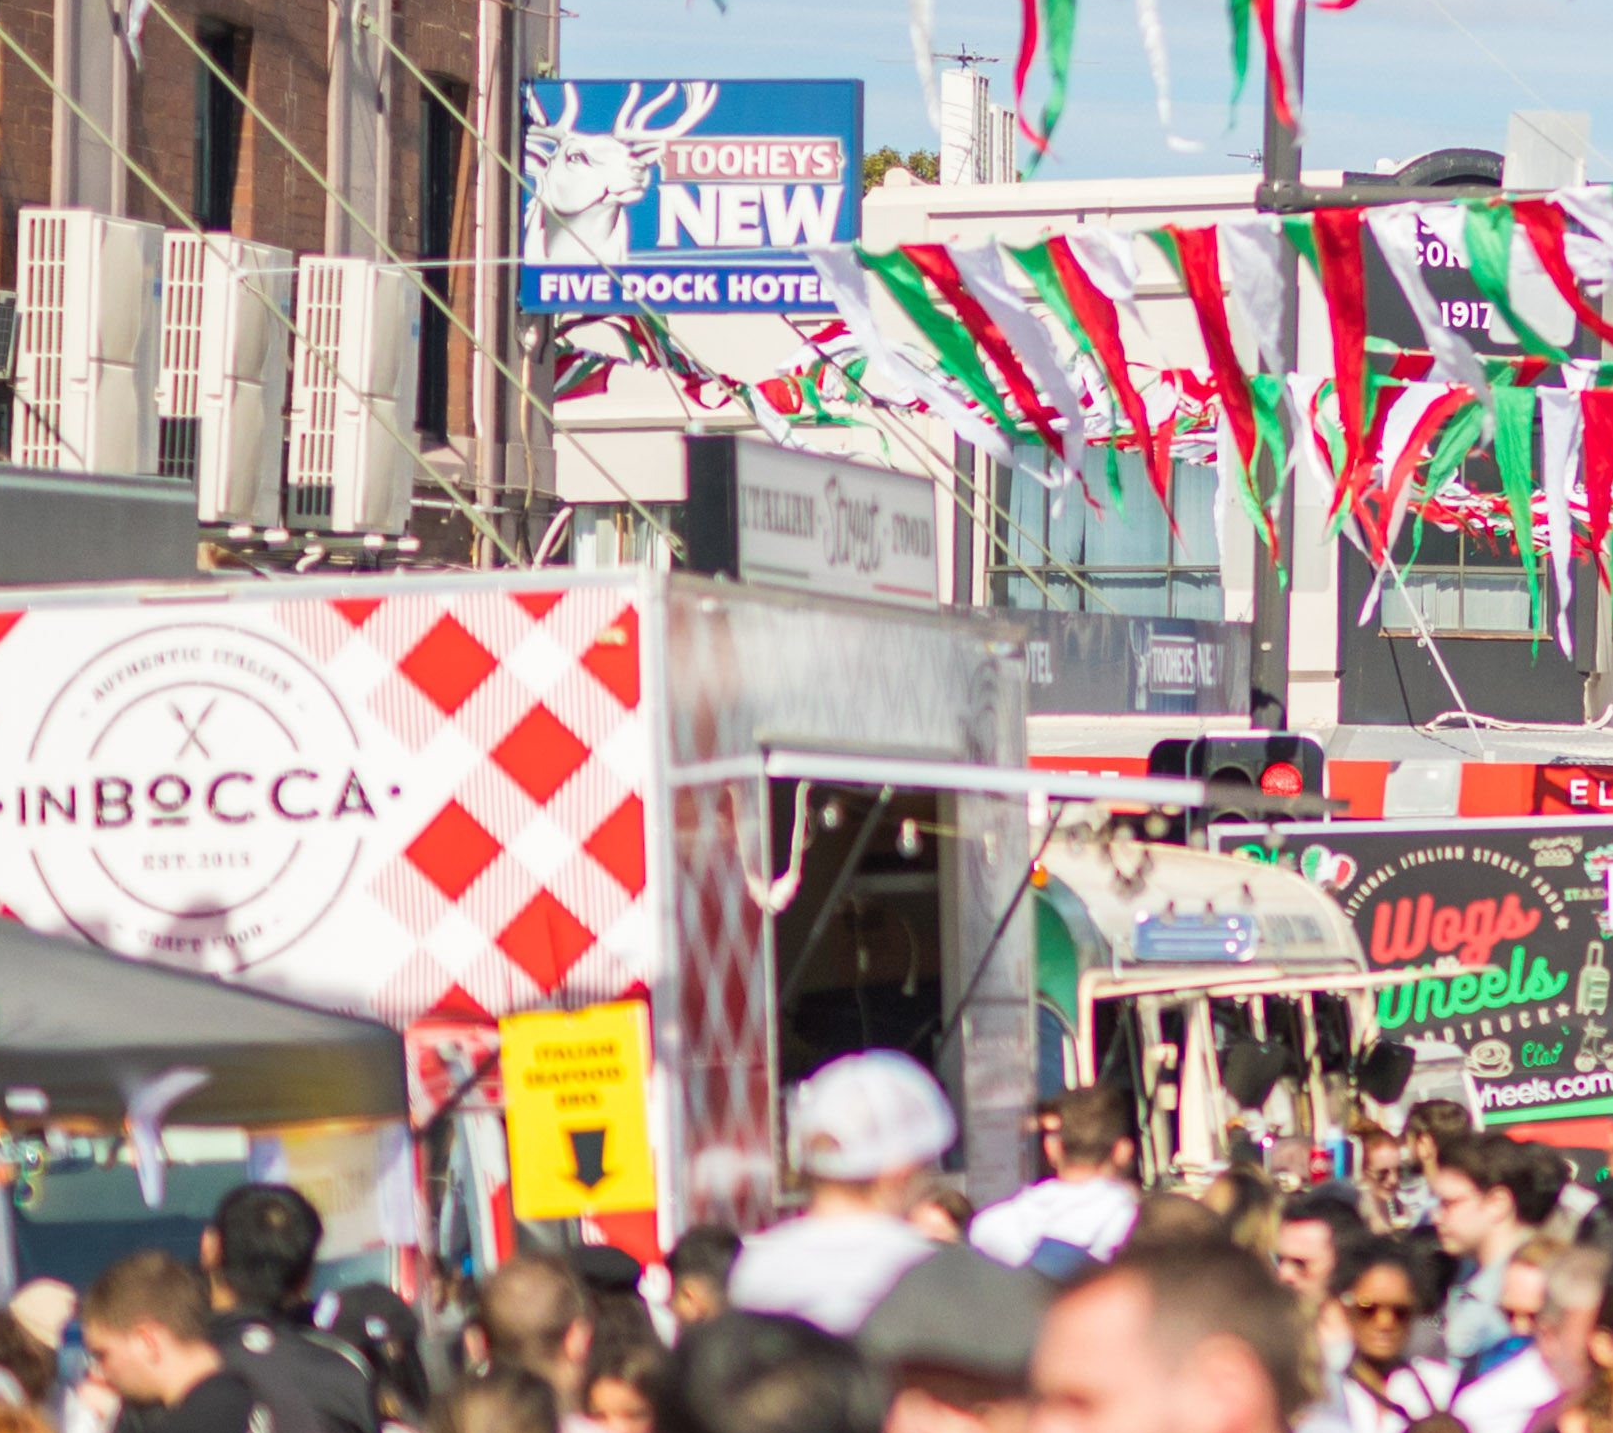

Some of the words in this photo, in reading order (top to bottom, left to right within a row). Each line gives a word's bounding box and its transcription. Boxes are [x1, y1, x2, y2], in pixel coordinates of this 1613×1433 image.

[670, 144, 833, 175] TOOHEYS
[656, 184, 845, 247] NEW
[539, 273, 611, 302] FIVE
[621, 273, 718, 302] DOCK
[1440, 301, 1494, 329] 1917
[740, 484, 815, 540] ITALIAN
[893, 512, 932, 559] FOOD
[91, 647, 202, 703] AUTHENTIC
[213, 648, 293, 696] ITALIAN
[1026, 641, 1053, 684] TEL
[1152, 646, 1194, 685] TOOHEYS
[16, 766, 377, 830] INBOCCA
[1399, 844, 1466, 870] ITALIAN
[1472, 845, 1530, 880] STREET
[1529, 875, 1565, 914] FOOD
[212, 924, 263, 951] FOOD
[1370, 892, 1542, 967] Wogs
[536, 1043, 616, 1060] ITALIAN
[525, 1067, 623, 1086] SEAFOOD
